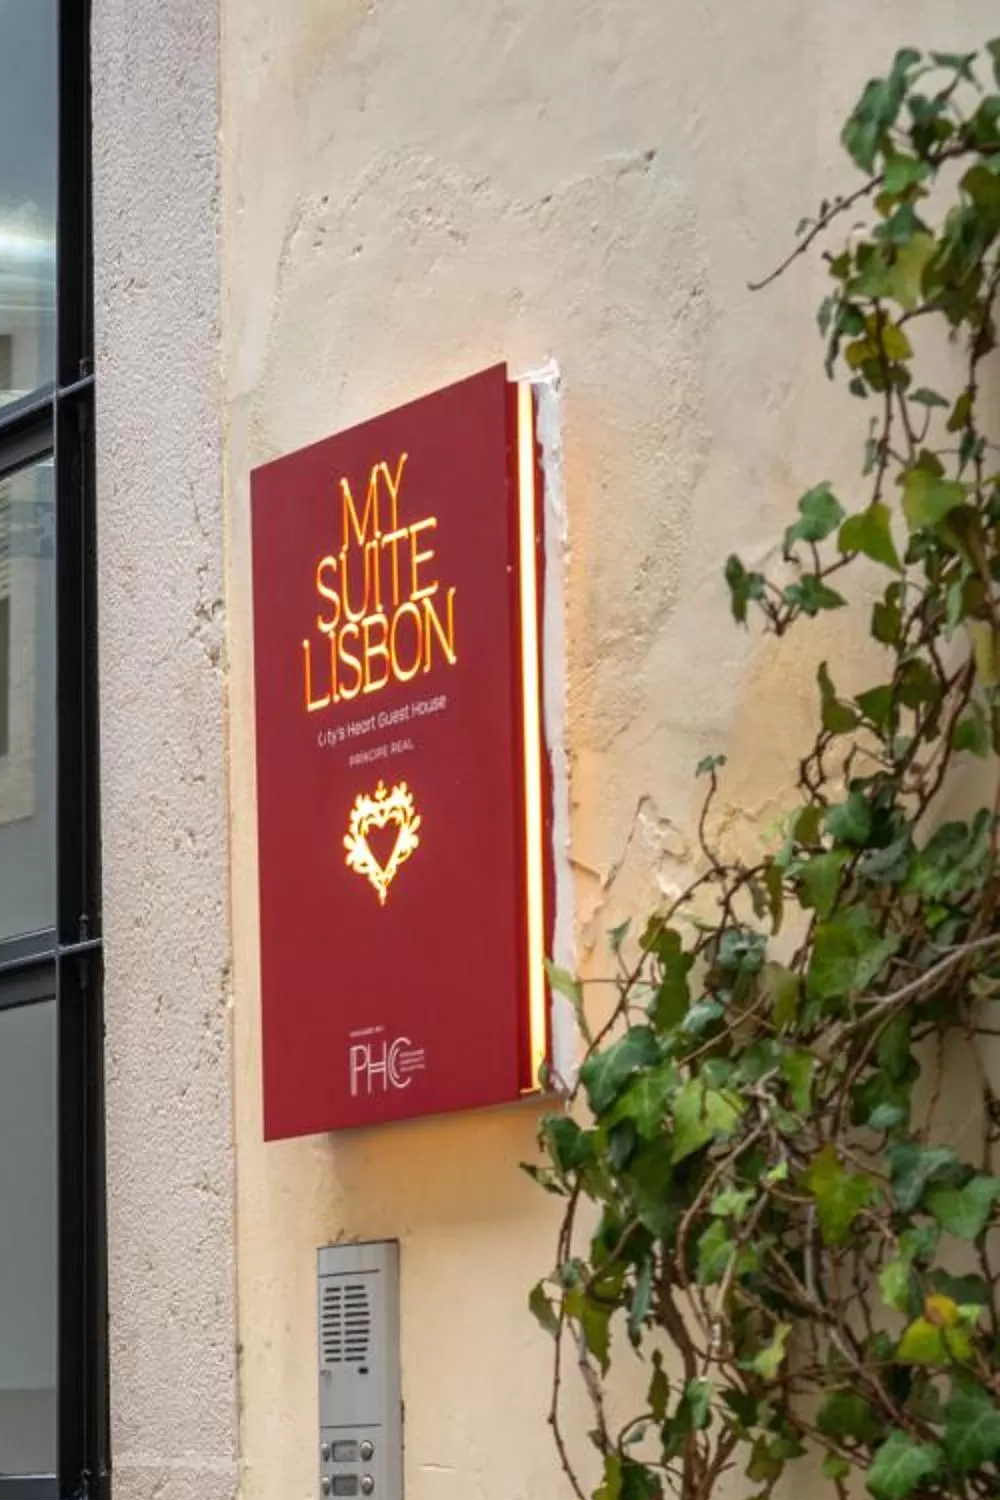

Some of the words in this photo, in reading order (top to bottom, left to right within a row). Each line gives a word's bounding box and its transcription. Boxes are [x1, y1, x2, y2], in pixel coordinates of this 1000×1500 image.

[340, 452, 408, 548] MY
[316, 516, 439, 632] SUITE
[303, 586, 456, 711] LISBON
[347, 715, 376, 736] Heart
[378, 704, 409, 728] Guest
[411, 694, 446, 718] House
[349, 1036, 412, 1096] PHC
